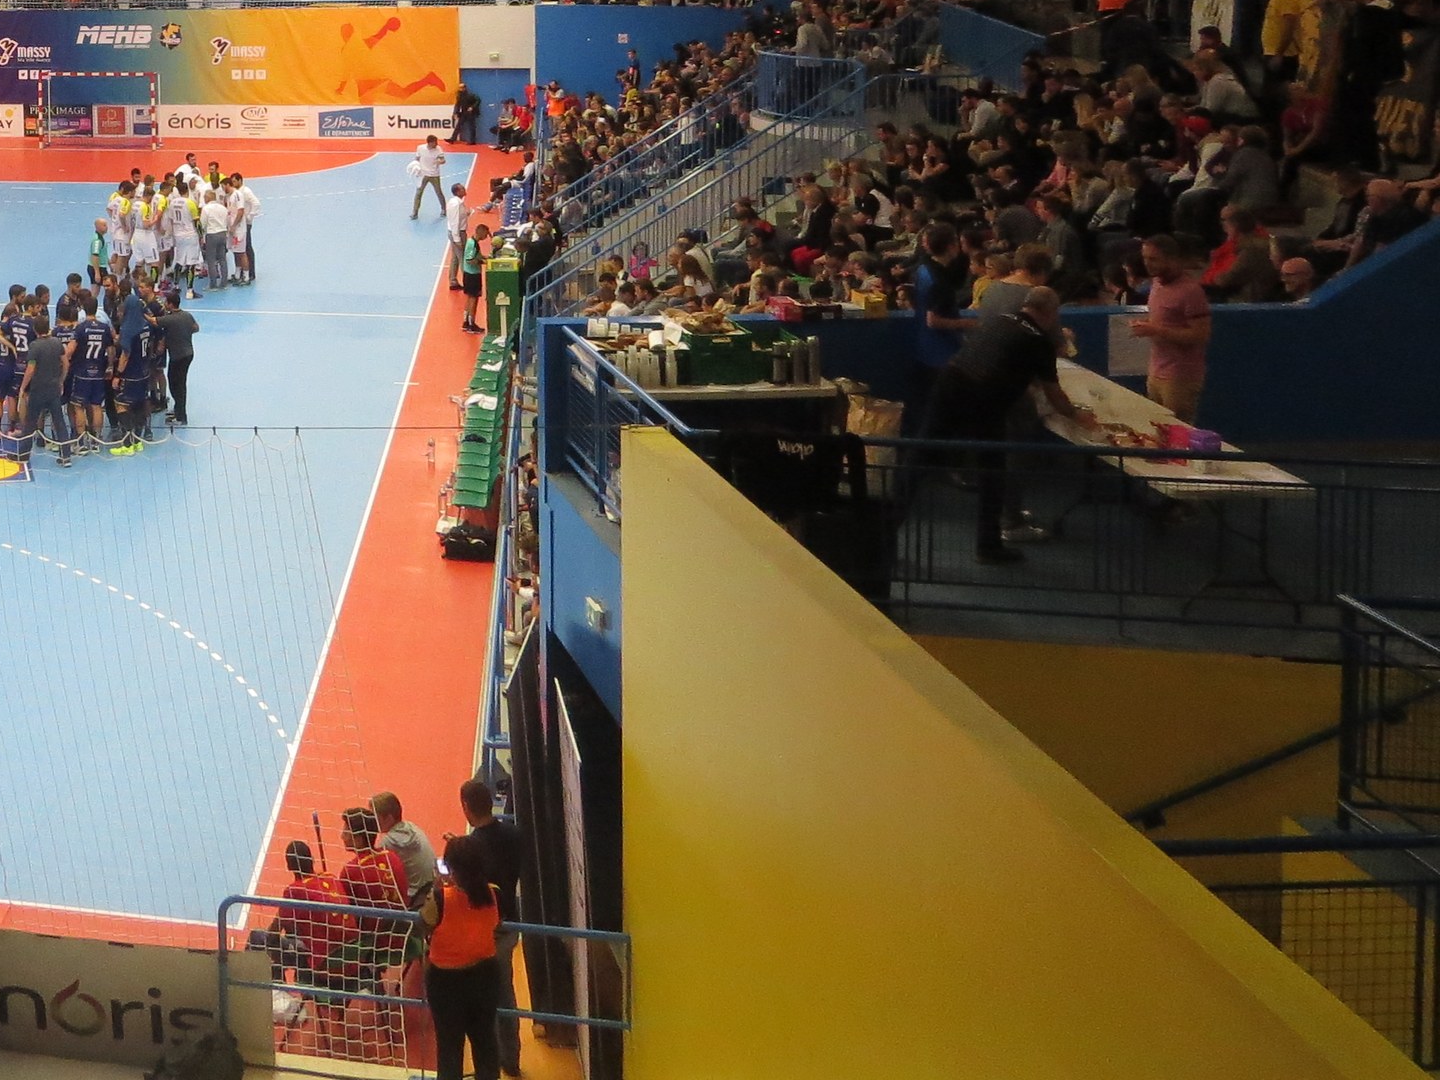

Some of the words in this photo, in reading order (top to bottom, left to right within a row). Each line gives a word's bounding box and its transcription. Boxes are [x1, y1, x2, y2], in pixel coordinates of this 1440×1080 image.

[76, 25, 153, 44] MEHB
[18, 47, 51, 57] MASSY
[231, 46, 266, 57] MASSY
[13, 333, 29, 351] 23
[85, 341, 102, 359] 77
